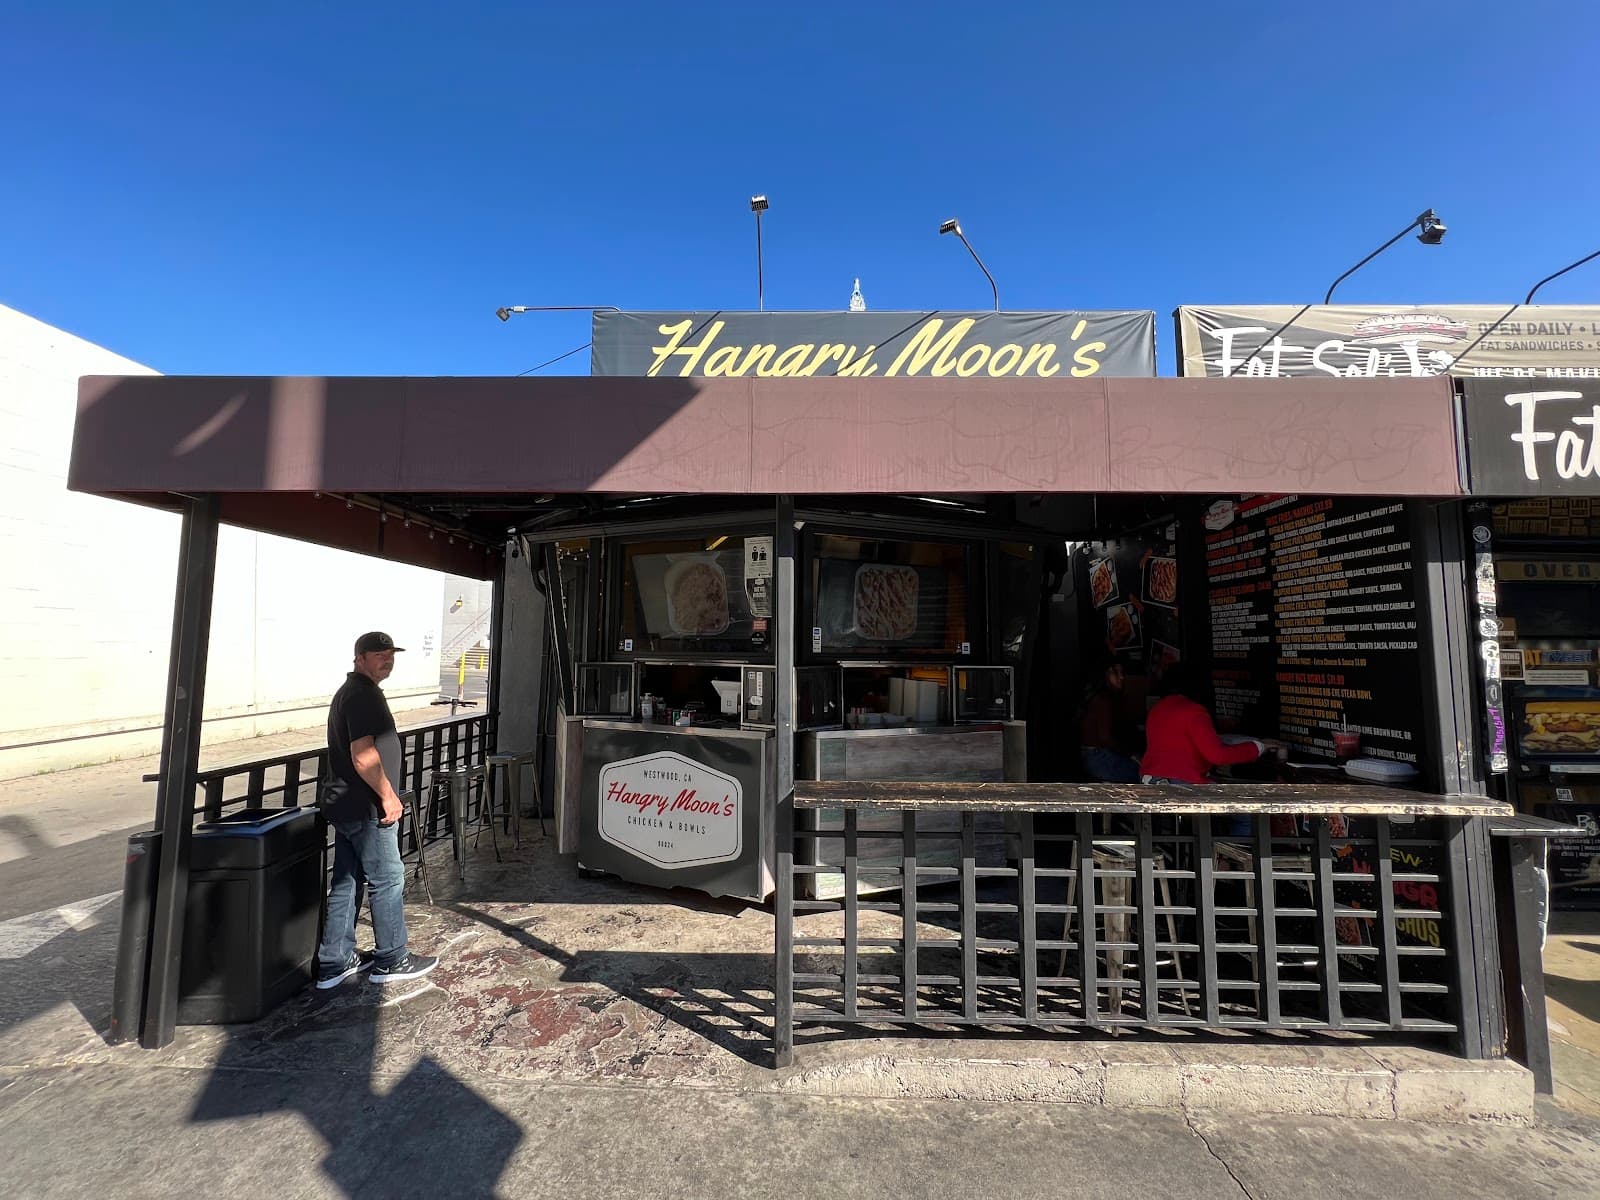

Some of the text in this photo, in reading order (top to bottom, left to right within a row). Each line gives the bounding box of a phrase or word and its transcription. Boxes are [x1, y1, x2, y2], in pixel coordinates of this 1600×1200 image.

[1478, 322, 1520, 336] OPEN
[1527, 322, 1574, 336] DAILY
[888, 318, 1108, 377] Moon's
[1480, 341, 1501, 351] FAT
[1505, 341, 1584, 351] SANDWICHES
[1524, 563, 1591, 577] OVER
[1389, 641, 1407, 650] PICKLED
[1341, 688, 1356, 698] STEAK
[1356, 690, 1372, 700] BOWL
[1330, 699, 1344, 709] BOWL
[1325, 710, 1339, 720] BOWL
[1361, 726, 1372, 736] LIME
[1372, 727, 1389, 738] BROWN
[643, 769, 692, 782] WESTWOOD, CA
[607, 781, 735, 817] Hangry Moon's
[627, 815, 706, 835] CHICKEN & BOWLS
